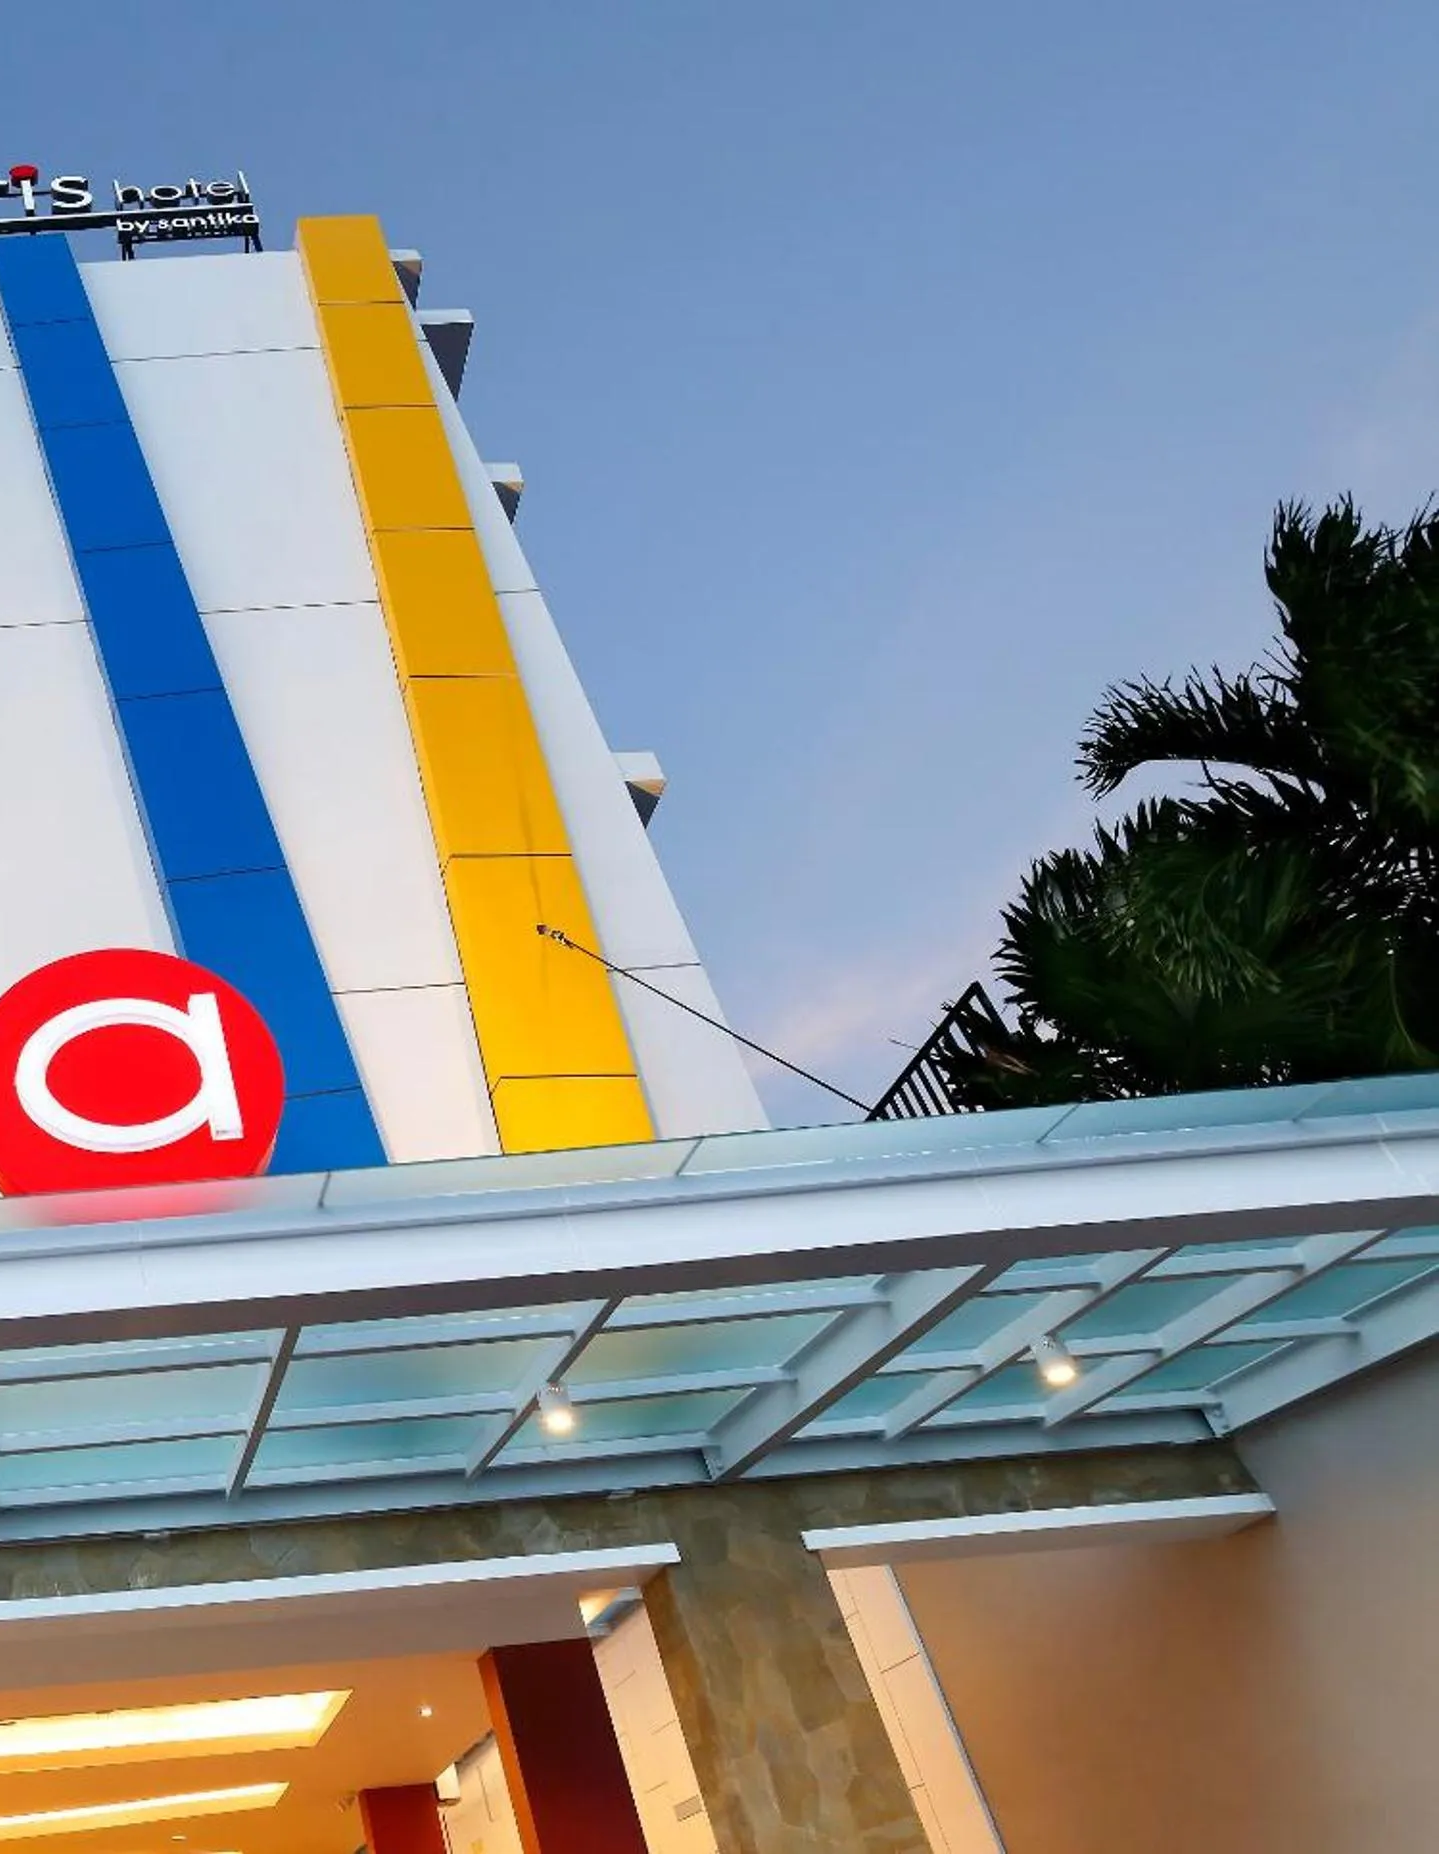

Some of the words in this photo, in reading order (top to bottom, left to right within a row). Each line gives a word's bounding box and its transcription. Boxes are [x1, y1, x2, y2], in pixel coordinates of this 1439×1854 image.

[112, 170, 250, 205] hotel
[116, 218, 150, 233] by
[158, 212, 260, 230] santika
[14, 992, 244, 1154] a
